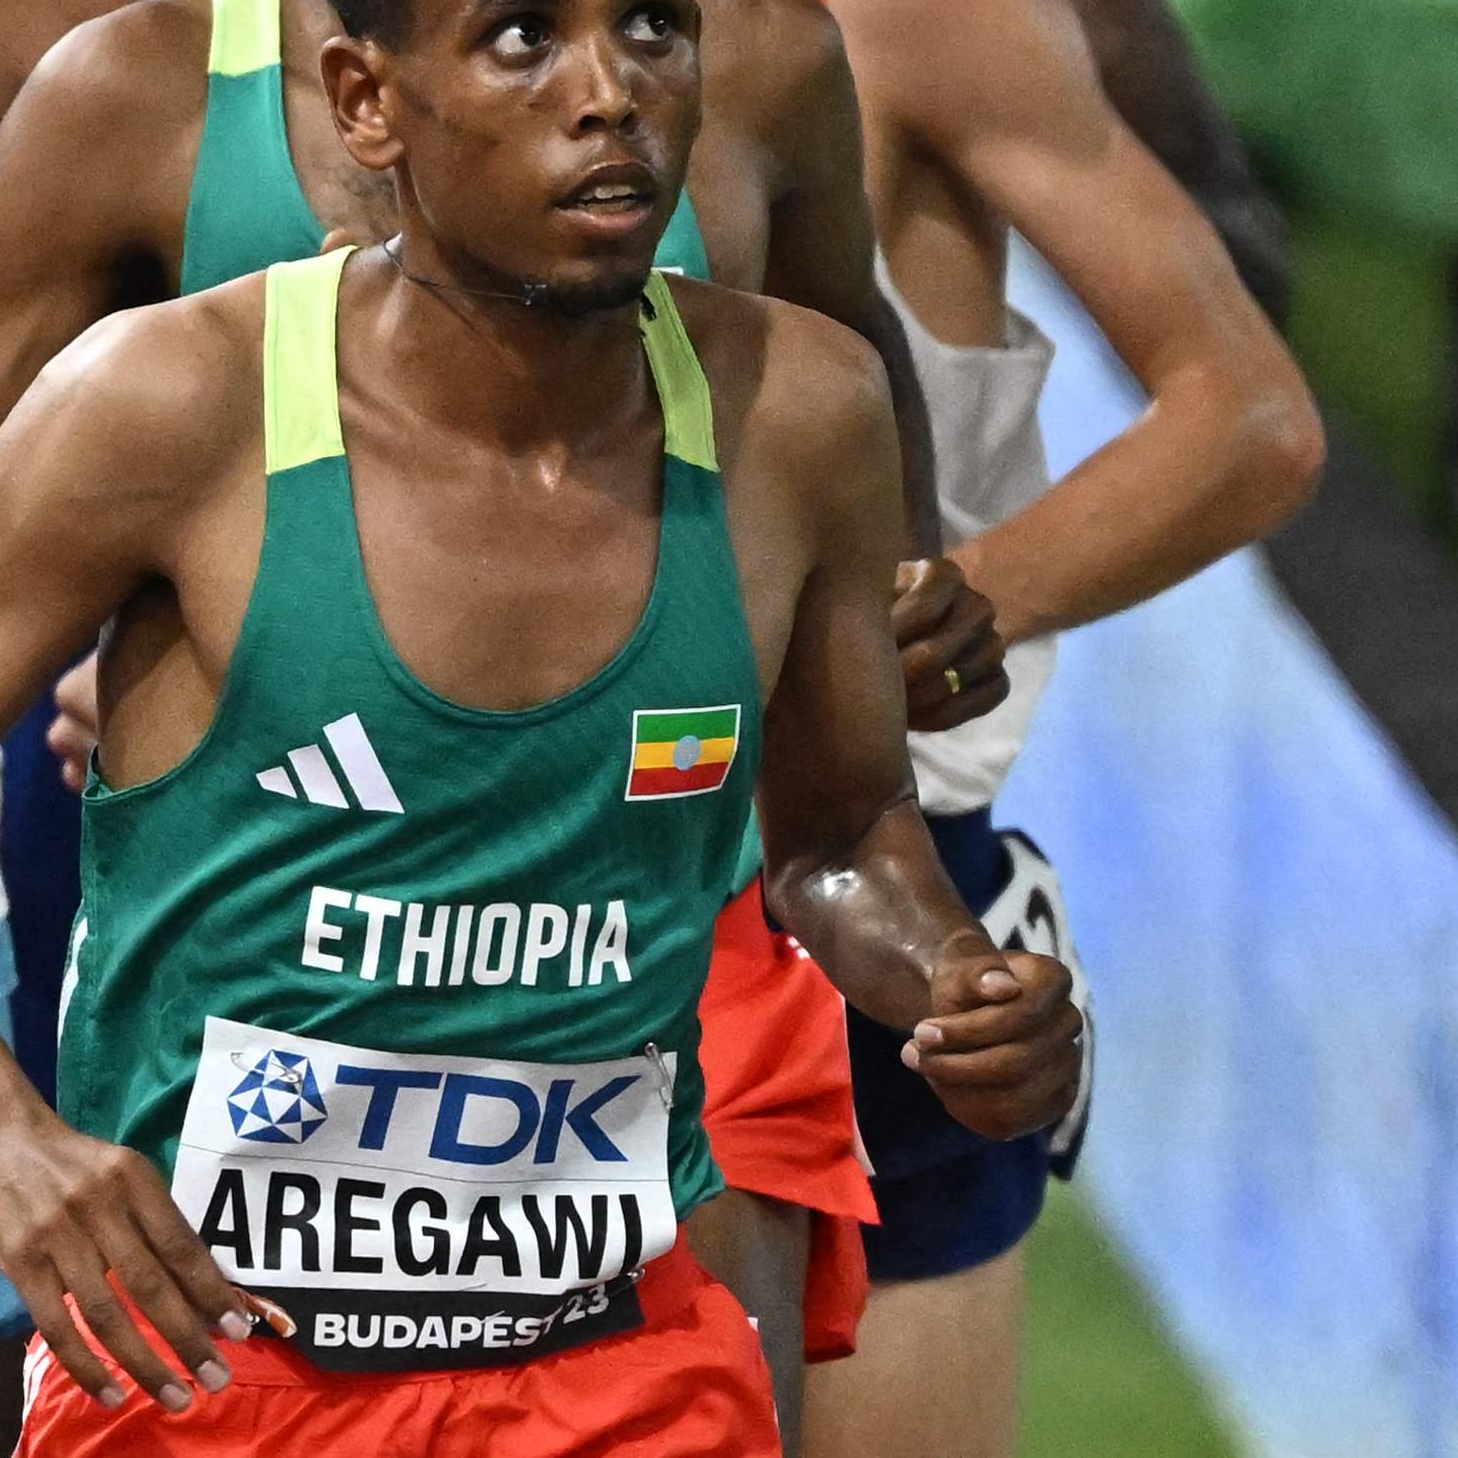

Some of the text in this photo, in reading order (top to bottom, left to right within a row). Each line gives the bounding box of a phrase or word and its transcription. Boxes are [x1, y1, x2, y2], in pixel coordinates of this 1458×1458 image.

[301, 885, 632, 988] ETHIOPIA
[334, 1063, 642, 1167] TDK
[199, 1168, 644, 1280] AREGAWI
